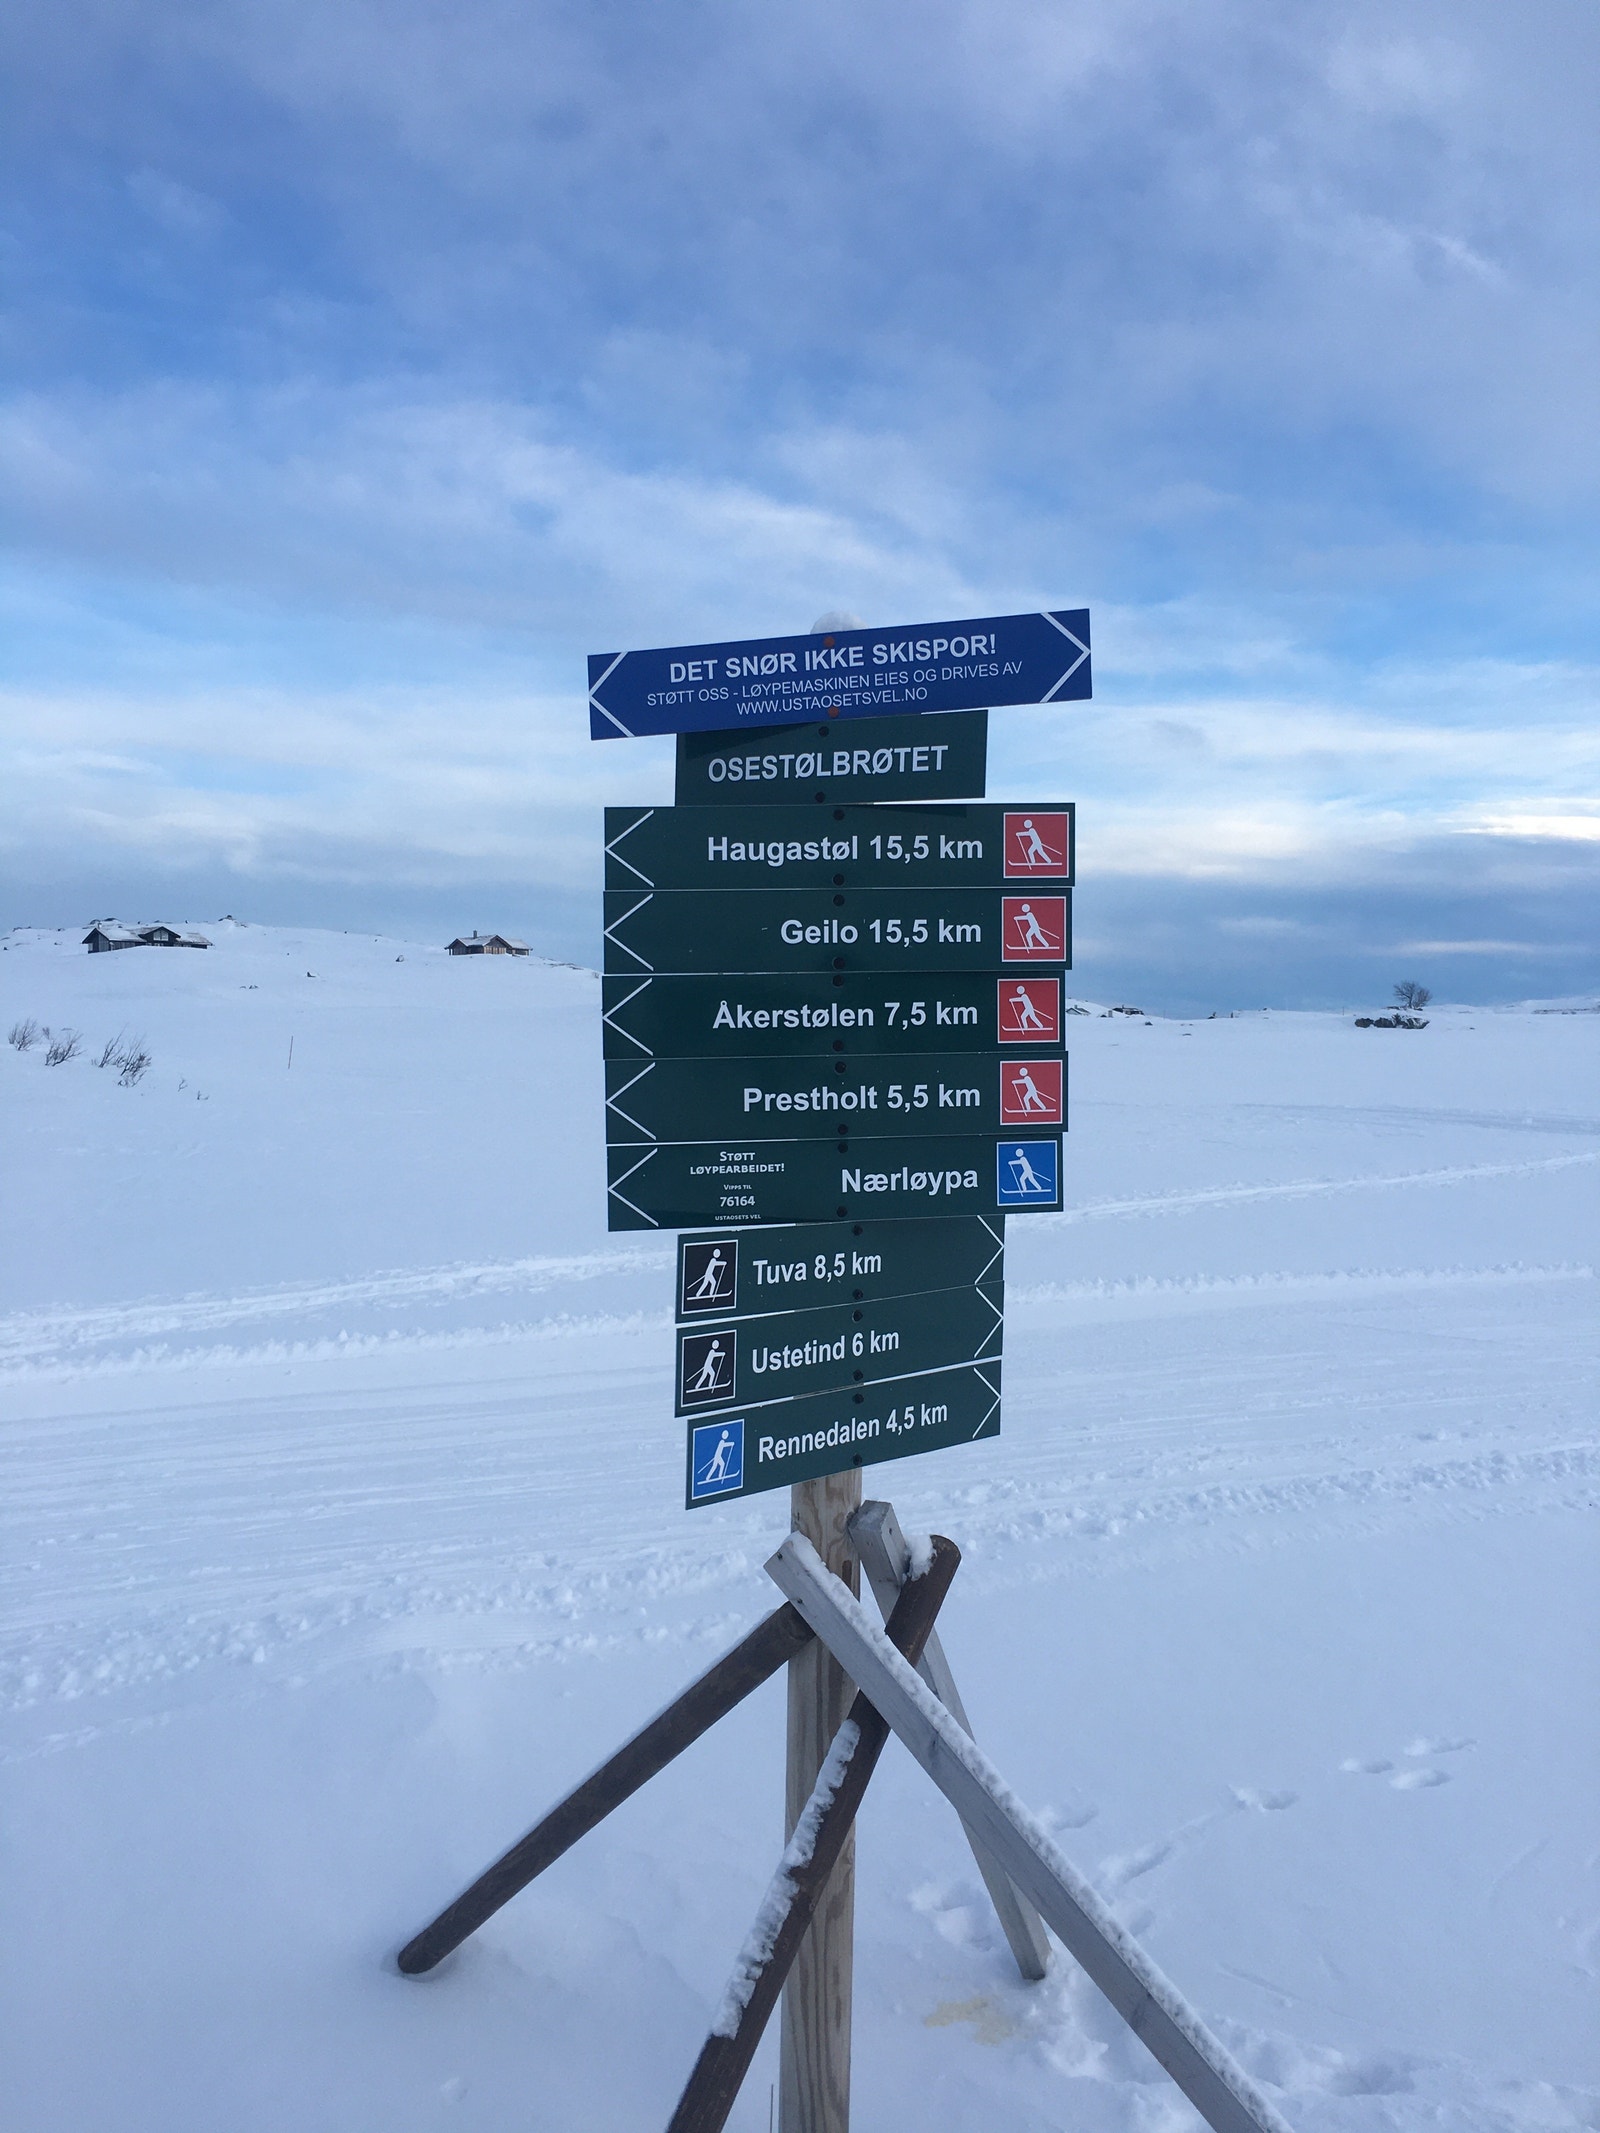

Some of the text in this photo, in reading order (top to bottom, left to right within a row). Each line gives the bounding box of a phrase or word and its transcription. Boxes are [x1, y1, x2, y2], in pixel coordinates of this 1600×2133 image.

[670, 633, 996, 683] DET SNØR IKKE SKISPOR!
[647, 690, 694, 706] STØTT
[698, 686, 729, 702] OSS
[742, 675, 870, 698] LØYPEMASKINEN
[874, 671, 909, 687] EIES
[913, 668, 937, 683] OG
[941, 663, 999, 681] DRIVES
[1002, 661, 1023, 675] AV
[736, 687, 928, 716] WWW.USTAOSETSVEL.NO
[708, 745, 949, 783] OSESTØLBRØTET
[707, 834, 984, 867] Haugastøl 15,5 km
[780, 918, 982, 948] Geilo 15,5 km
[712, 1000, 979, 1031] Åkerstølen 7,5 km
[743, 1083, 981, 1113] Prestholt 5,5 km
[841, 1167, 979, 1195] Nærløypa
[719, 1195, 756, 1208] 76164
[753, 1251, 882, 1285] Tuva 8,5 km
[751, 1330, 900, 1374] Ustetind 6 km
[758, 1402, 948, 1463] Rennedalen 4,5 km
